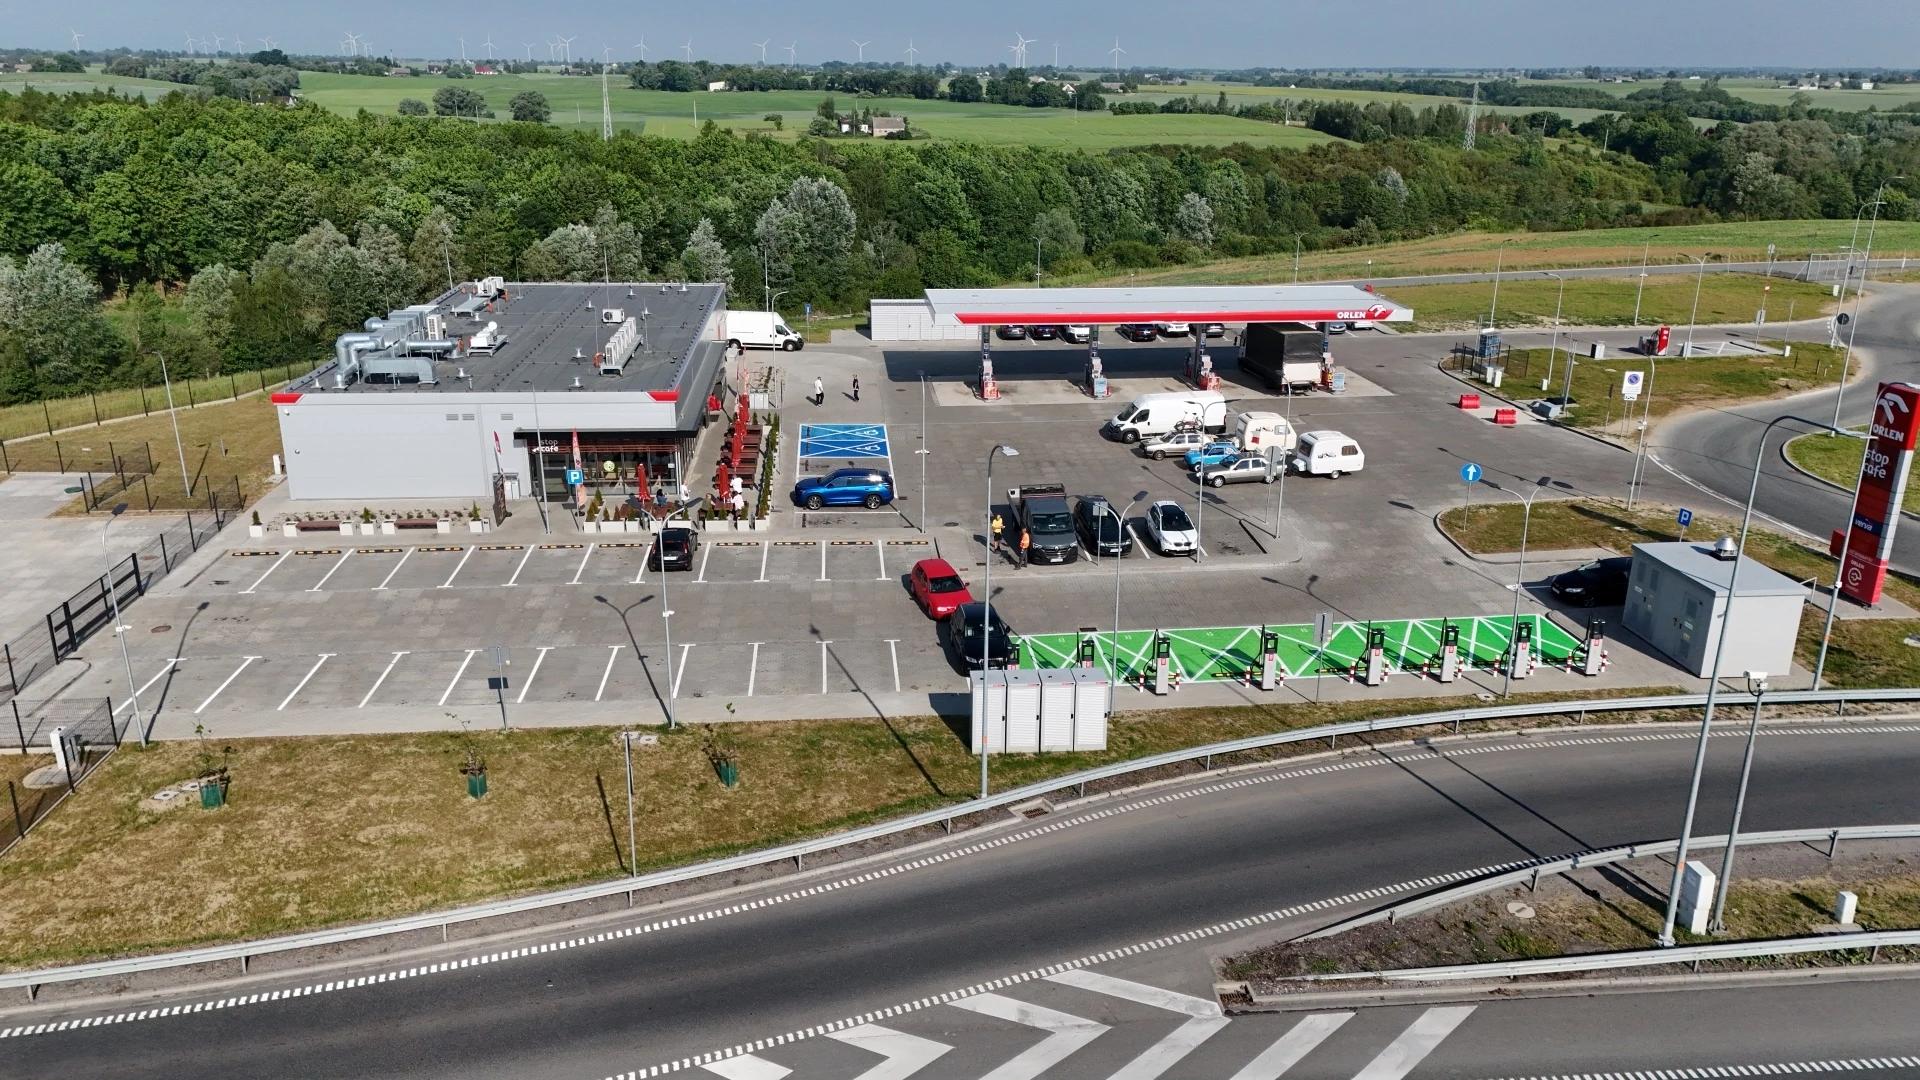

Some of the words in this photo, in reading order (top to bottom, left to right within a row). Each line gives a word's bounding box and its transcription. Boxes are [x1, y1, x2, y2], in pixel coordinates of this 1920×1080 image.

[1336, 311, 1366, 319] ORLEN
[1872, 423, 1905, 442] ORLEN
[540, 438, 558, 447] stop
[540, 445, 559, 453] cafe
[1865, 449, 1889, 467] stop
[1863, 462, 1887, 478] cafe
[570, 472, 580, 482] P
[1680, 510, 1690, 523] P
[1854, 518, 1873, 531] verva
[1850, 559, 1865, 569] ORLEN
